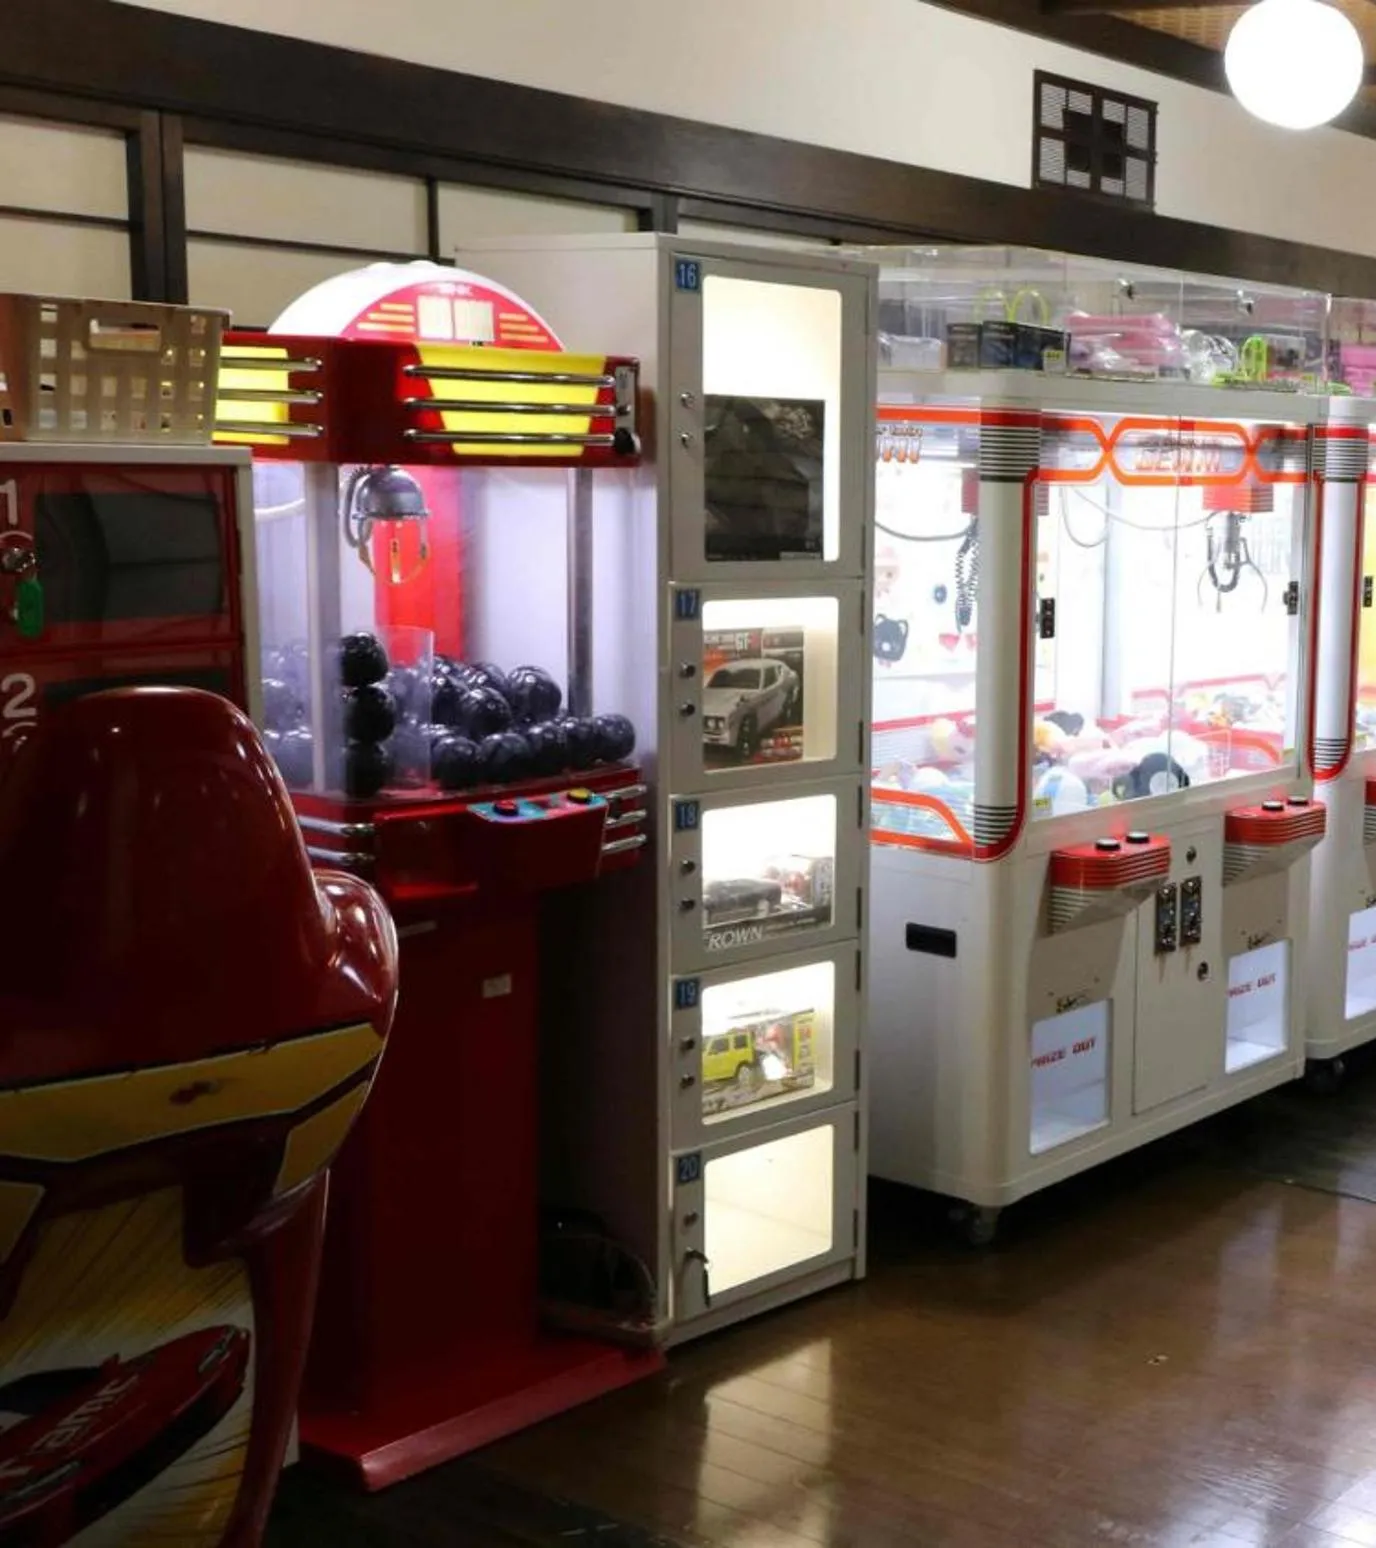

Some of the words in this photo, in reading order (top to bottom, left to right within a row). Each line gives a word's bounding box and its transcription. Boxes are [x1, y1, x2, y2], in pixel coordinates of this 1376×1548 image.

[680, 263, 697, 288] 16
[0, 479, 18, 525] 1
[680, 592, 697, 617] 17
[1, 673, 37, 718] 2
[680, 803, 696, 828] 18
[680, 981, 696, 1006] 19
[680, 1156, 699, 1181] 20
